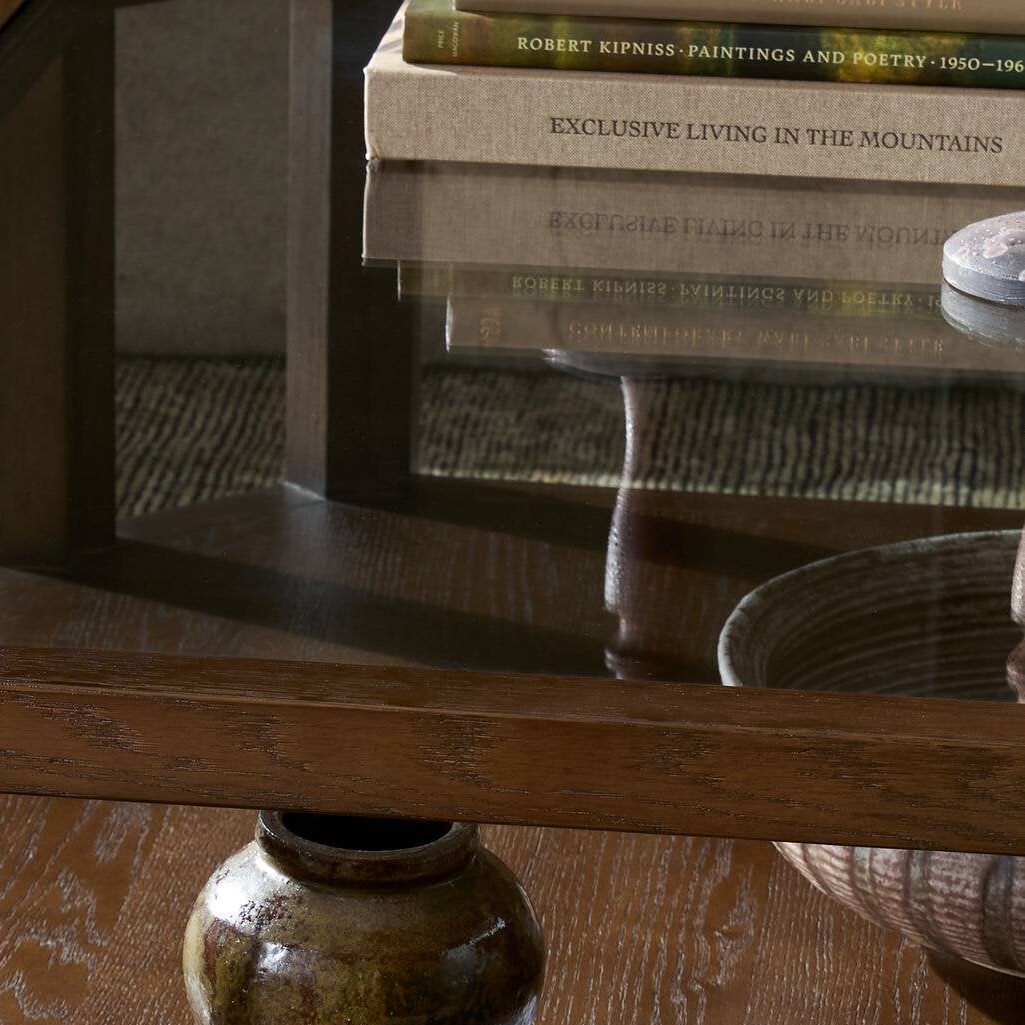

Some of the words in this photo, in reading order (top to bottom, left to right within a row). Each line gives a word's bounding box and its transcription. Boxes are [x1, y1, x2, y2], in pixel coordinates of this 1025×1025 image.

[518, 37, 592, 53] ROBERT
[600, 41, 676, 57] KIPNISS
[687, 44, 795, 62] PAINTINGS
[803, 50, 846, 65] AND
[852, 52, 927, 68] POETRY
[939, 56, 1025, 73] 1950–196
[550, 117, 681, 140] EXCLUSIVE
[686, 123, 767, 144] LIVING
[774, 127, 799, 145] IN
[806, 129, 855, 147] THE
[860, 131, 1004, 154] MOUNTAINS
